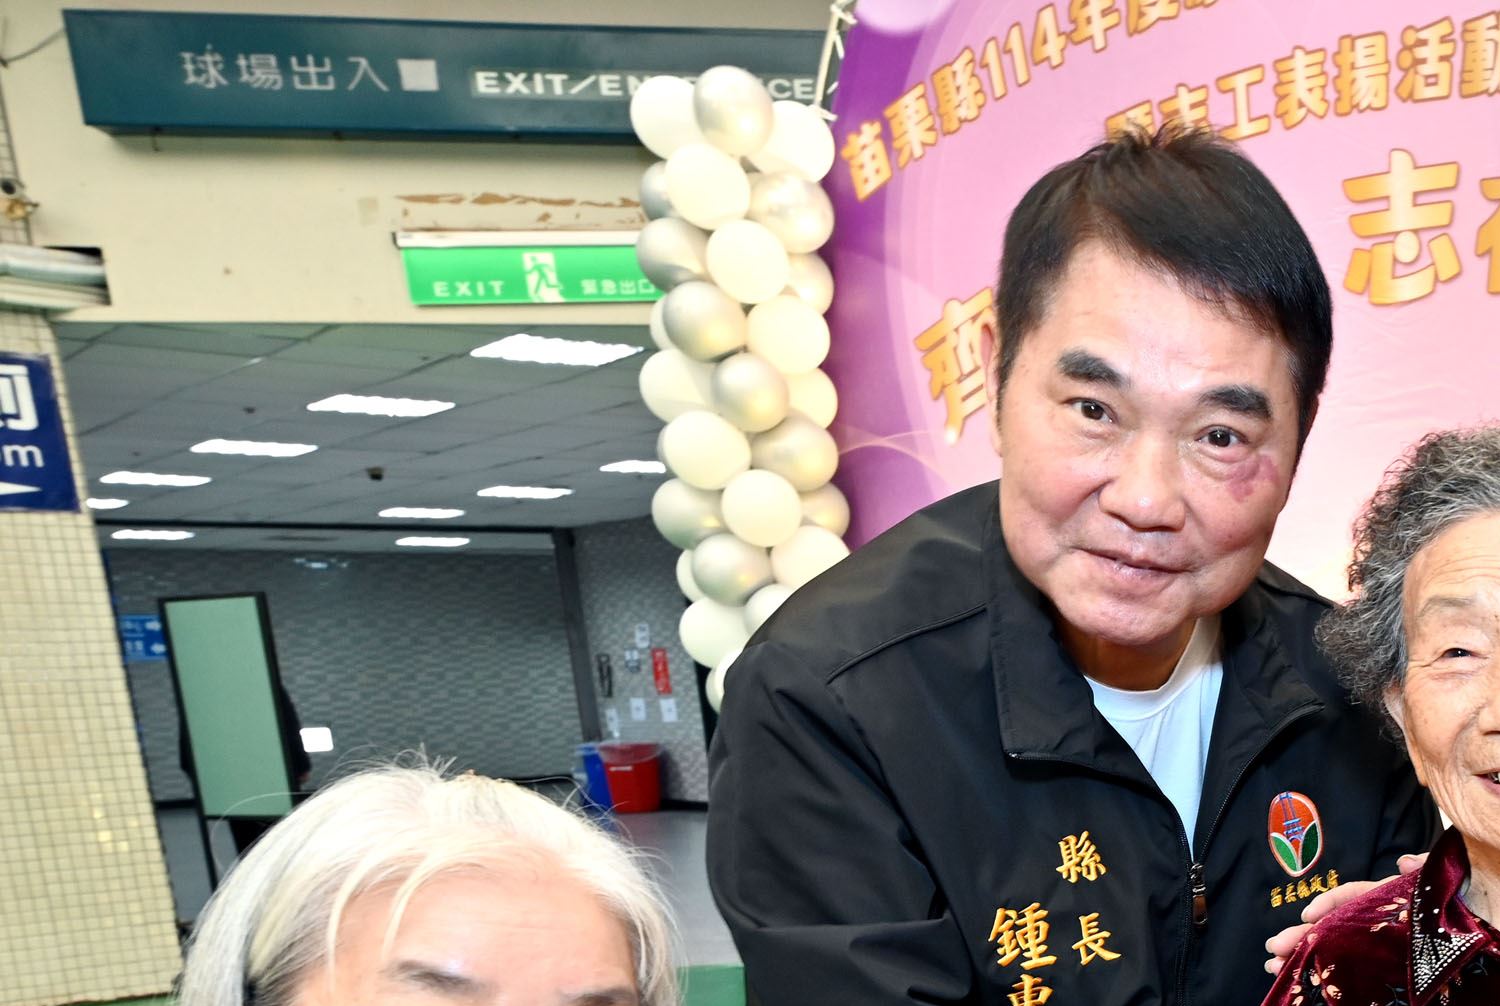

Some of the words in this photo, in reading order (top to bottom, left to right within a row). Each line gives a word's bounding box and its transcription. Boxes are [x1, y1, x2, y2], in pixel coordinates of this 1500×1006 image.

[179, 43, 439, 92] 球場出入
[474, 70, 816, 100] EXIT/ECE
[840, 0, 1220, 203] 苗栗縣114年度
[432, 280, 505, 298] EXIT
[1055, 829, 1122, 967] 縣長
